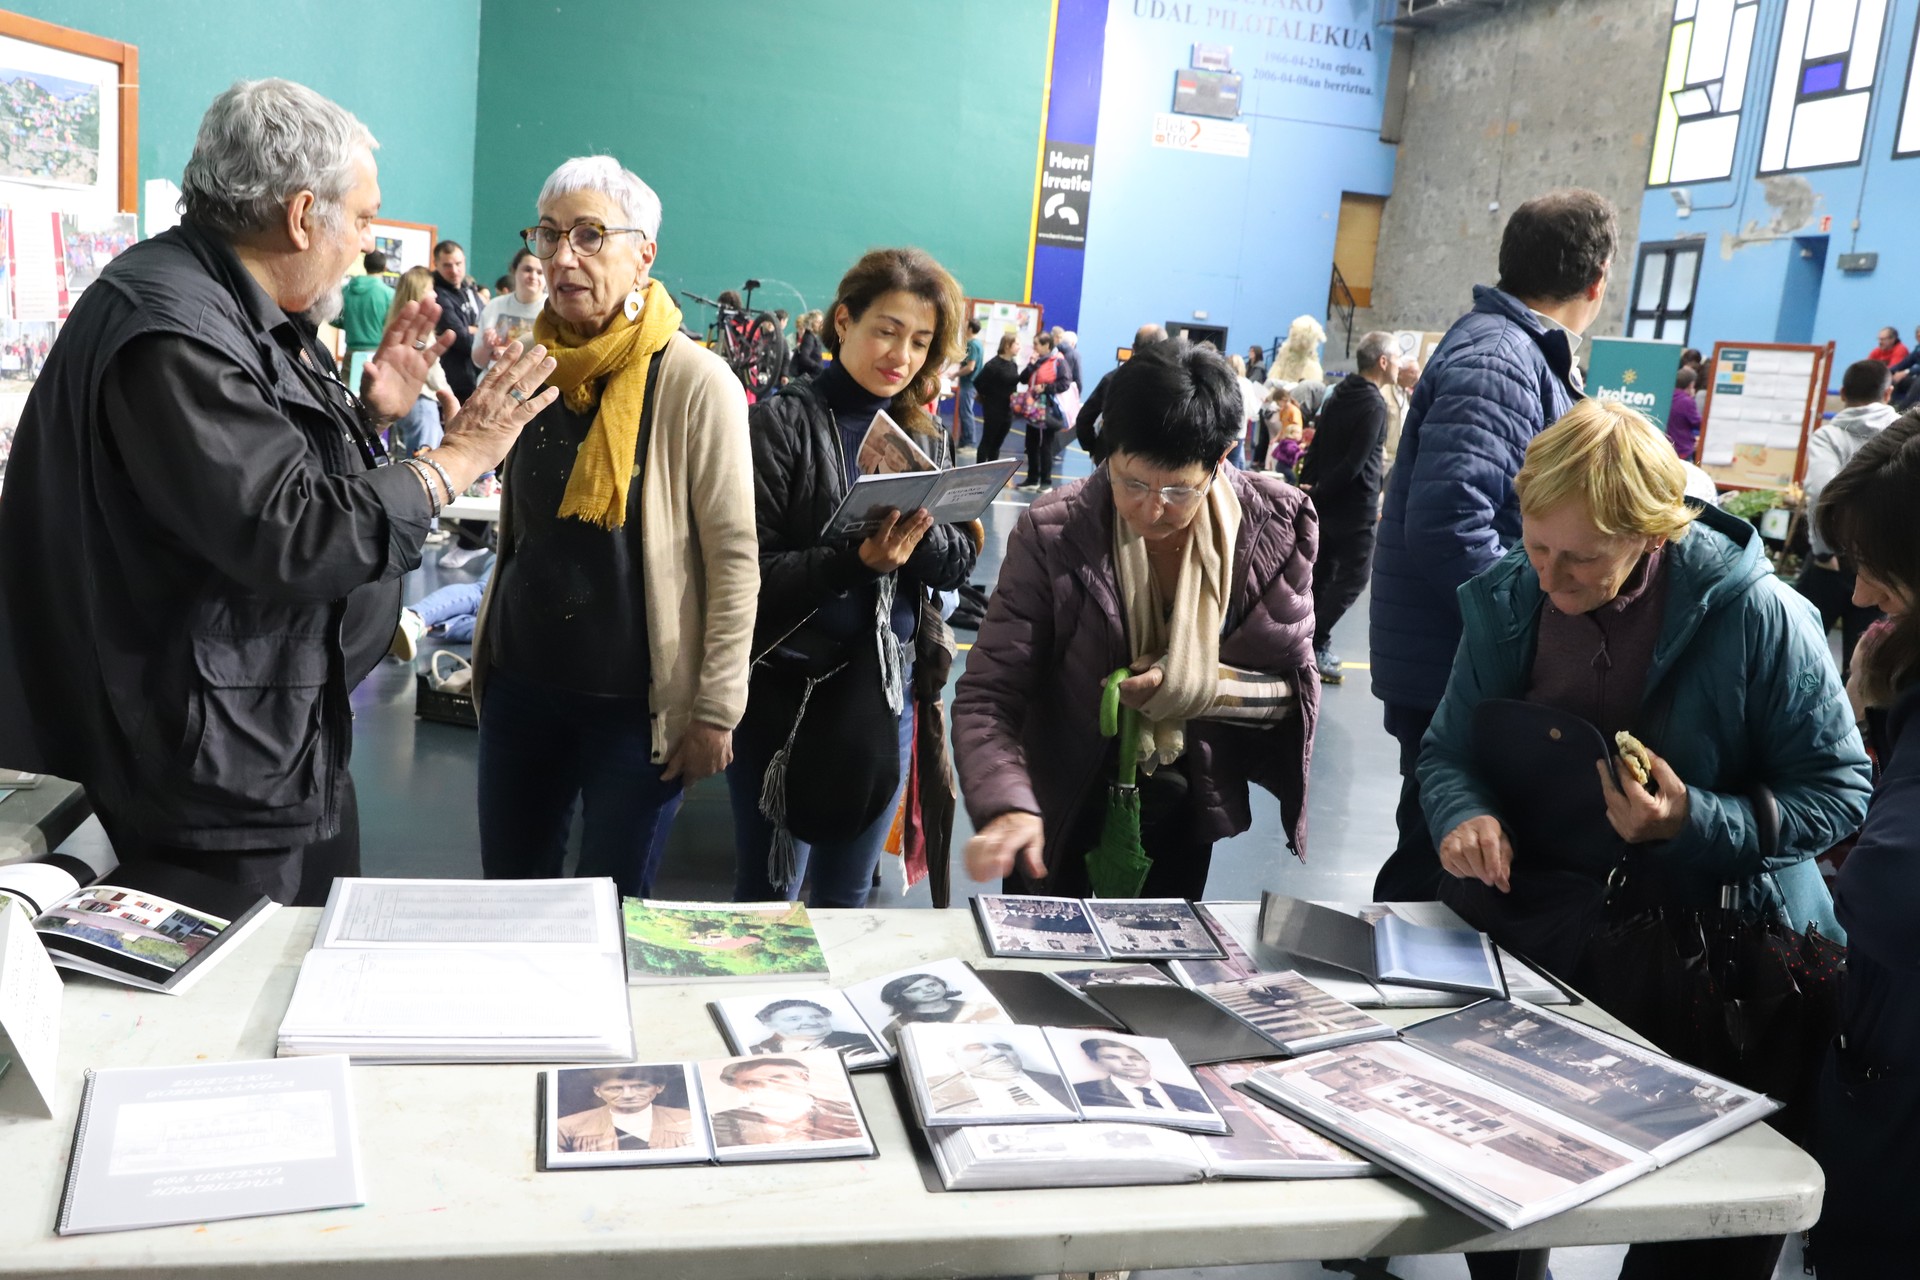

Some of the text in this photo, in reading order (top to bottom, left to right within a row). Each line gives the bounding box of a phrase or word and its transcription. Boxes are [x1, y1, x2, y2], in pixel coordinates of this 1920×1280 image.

[1133, 0, 1198, 25] UDAL
[1207, 7, 1373, 51] PILOTALEKUA
[1049, 150, 1090, 171] Herri
[1042, 171, 1092, 192] Irratia
